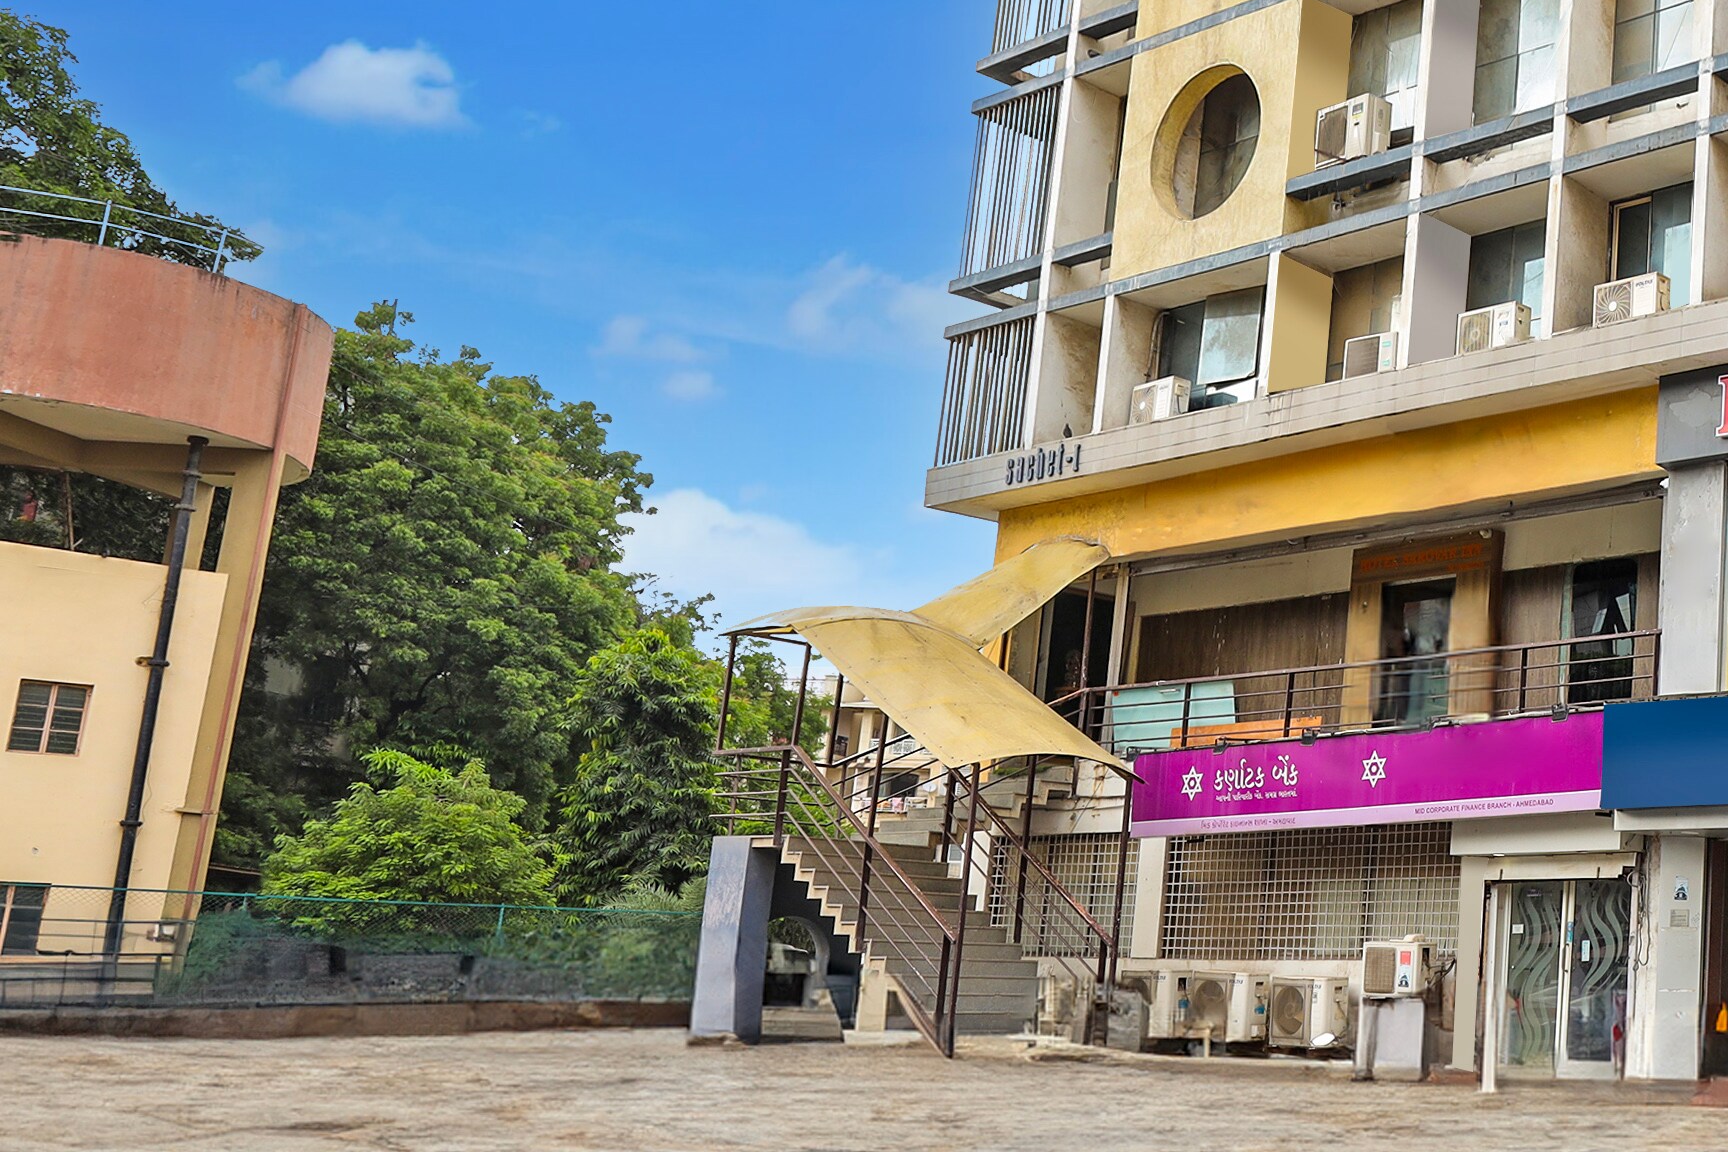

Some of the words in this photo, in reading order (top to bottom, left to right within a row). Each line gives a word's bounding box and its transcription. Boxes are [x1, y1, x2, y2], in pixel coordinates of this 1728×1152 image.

[1213, 758, 1265, 792] કર્ણાટક
[1426, 805, 1460, 814] CORPORATE
[1461, 803, 1486, 812] FINANCE
[1487, 801, 1512, 810] BRANCH
[1516, 799, 1554, 808] AHMEDABAD
